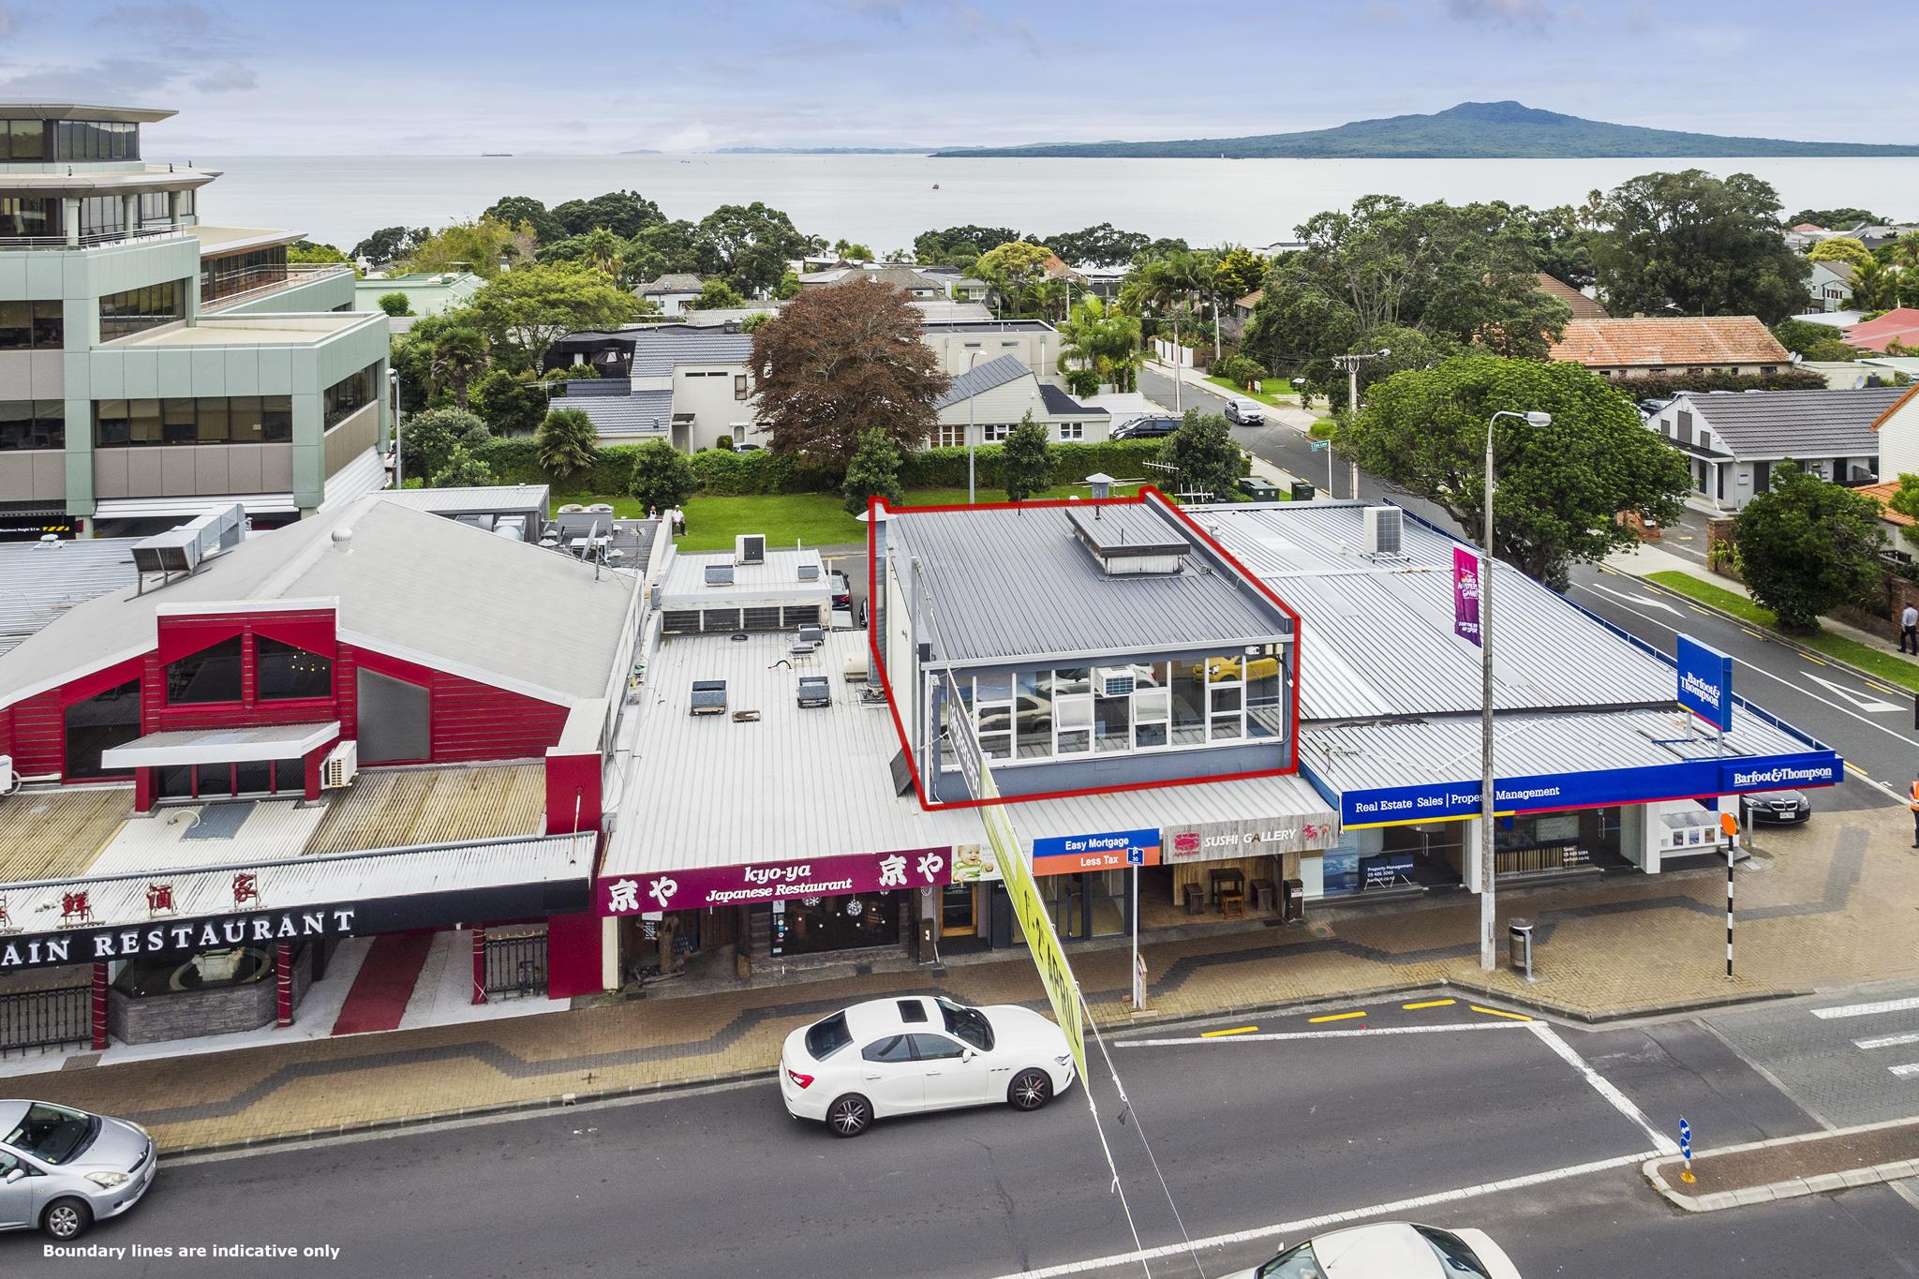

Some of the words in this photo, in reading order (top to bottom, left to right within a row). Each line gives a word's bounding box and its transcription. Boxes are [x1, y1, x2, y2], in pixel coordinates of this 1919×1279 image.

[1680, 676, 1719, 707] Thompson
[1688, 672, 1720, 698] Barfoot&
[1734, 768, 1832, 783] Barfoot&Thompson
[1356, 802, 1378, 813] Real
[1380, 800, 1413, 811] Estate
[1417, 797, 1443, 807] Sales
[1451, 793, 1483, 805] Prope
[1496, 786, 1560, 801] Management
[1065, 840, 1087, 851] Easy
[1089, 838, 1129, 848] Mortgage
[1205, 834, 1239, 848] SUSHI
[1243, 828, 1297, 844] GALLERY
[879, 852, 944, 886] 京や
[1081, 857, 1102, 867] Less
[1104, 855, 1119, 865] Tax
[744, 864, 812, 885] kyo-ya
[608, 876, 677, 912] 京や
[706, 887, 773, 903] Japanese
[775, 878, 852, 895] Restaurant
[1, 940, 71, 967] AIN
[94, 911, 355, 957] RESTAURANT
